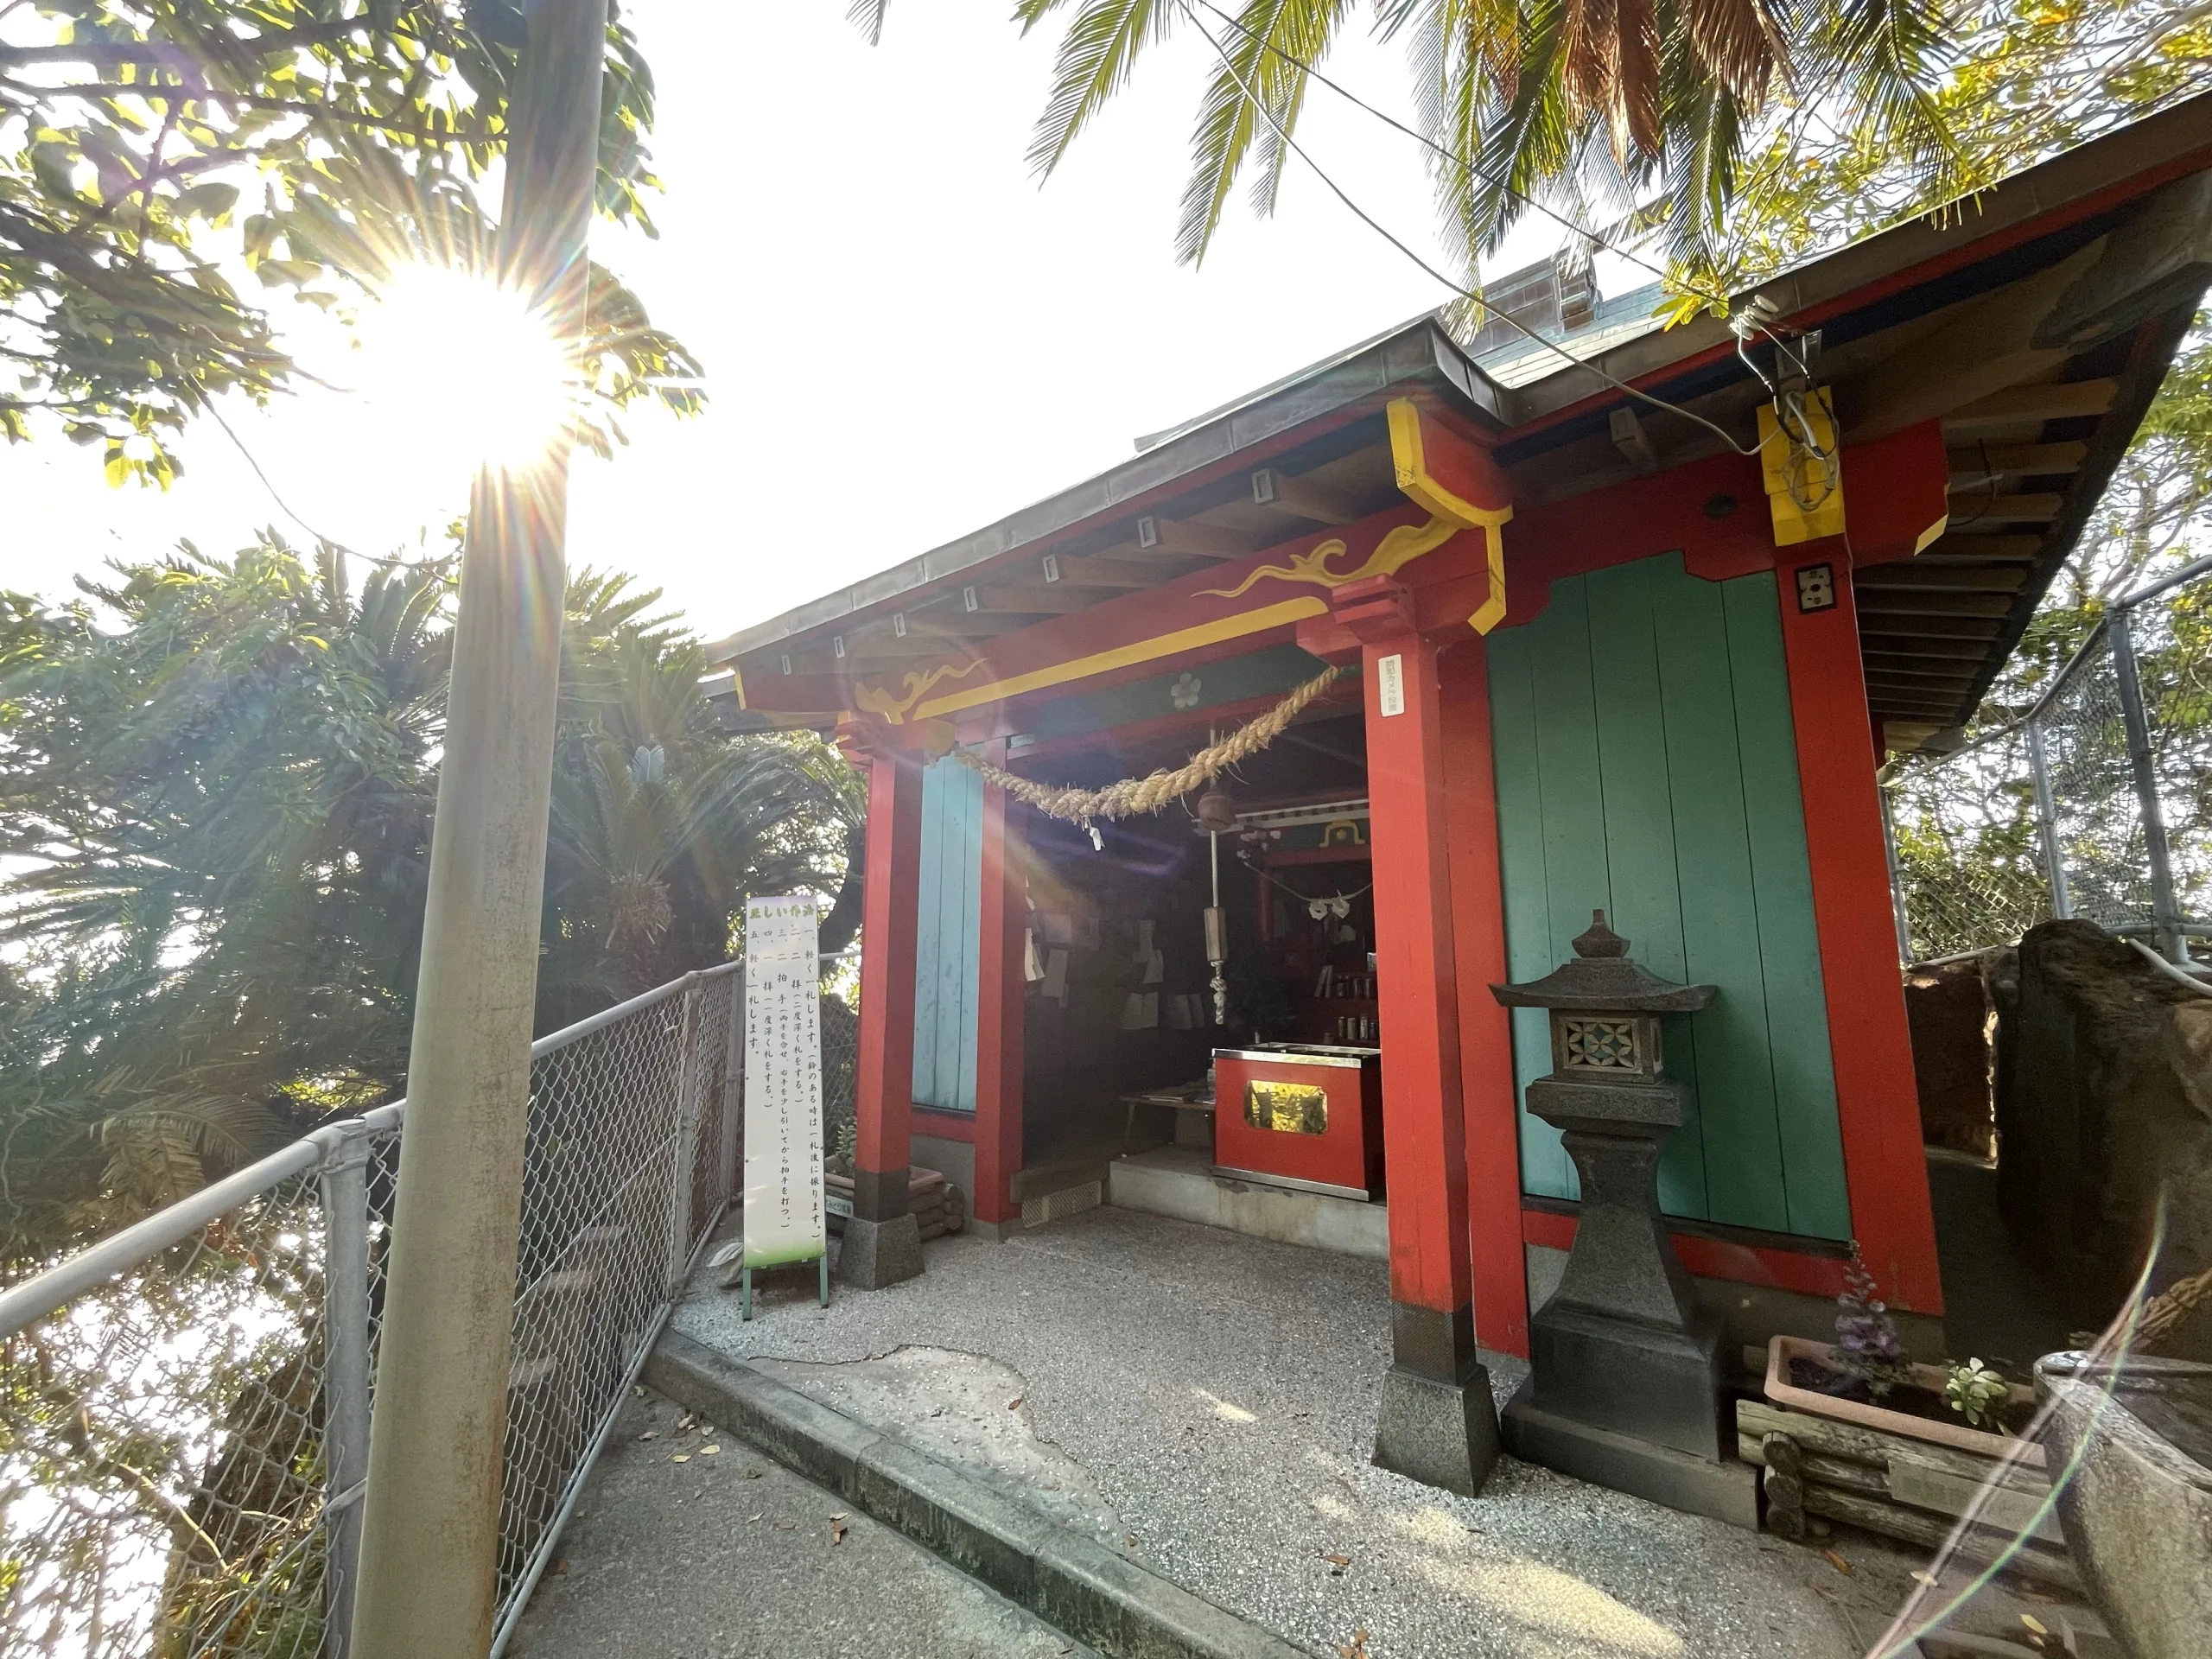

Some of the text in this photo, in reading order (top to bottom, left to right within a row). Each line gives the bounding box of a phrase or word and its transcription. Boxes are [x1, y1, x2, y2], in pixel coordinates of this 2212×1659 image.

[749, 904, 815, 918] 正しい作法
